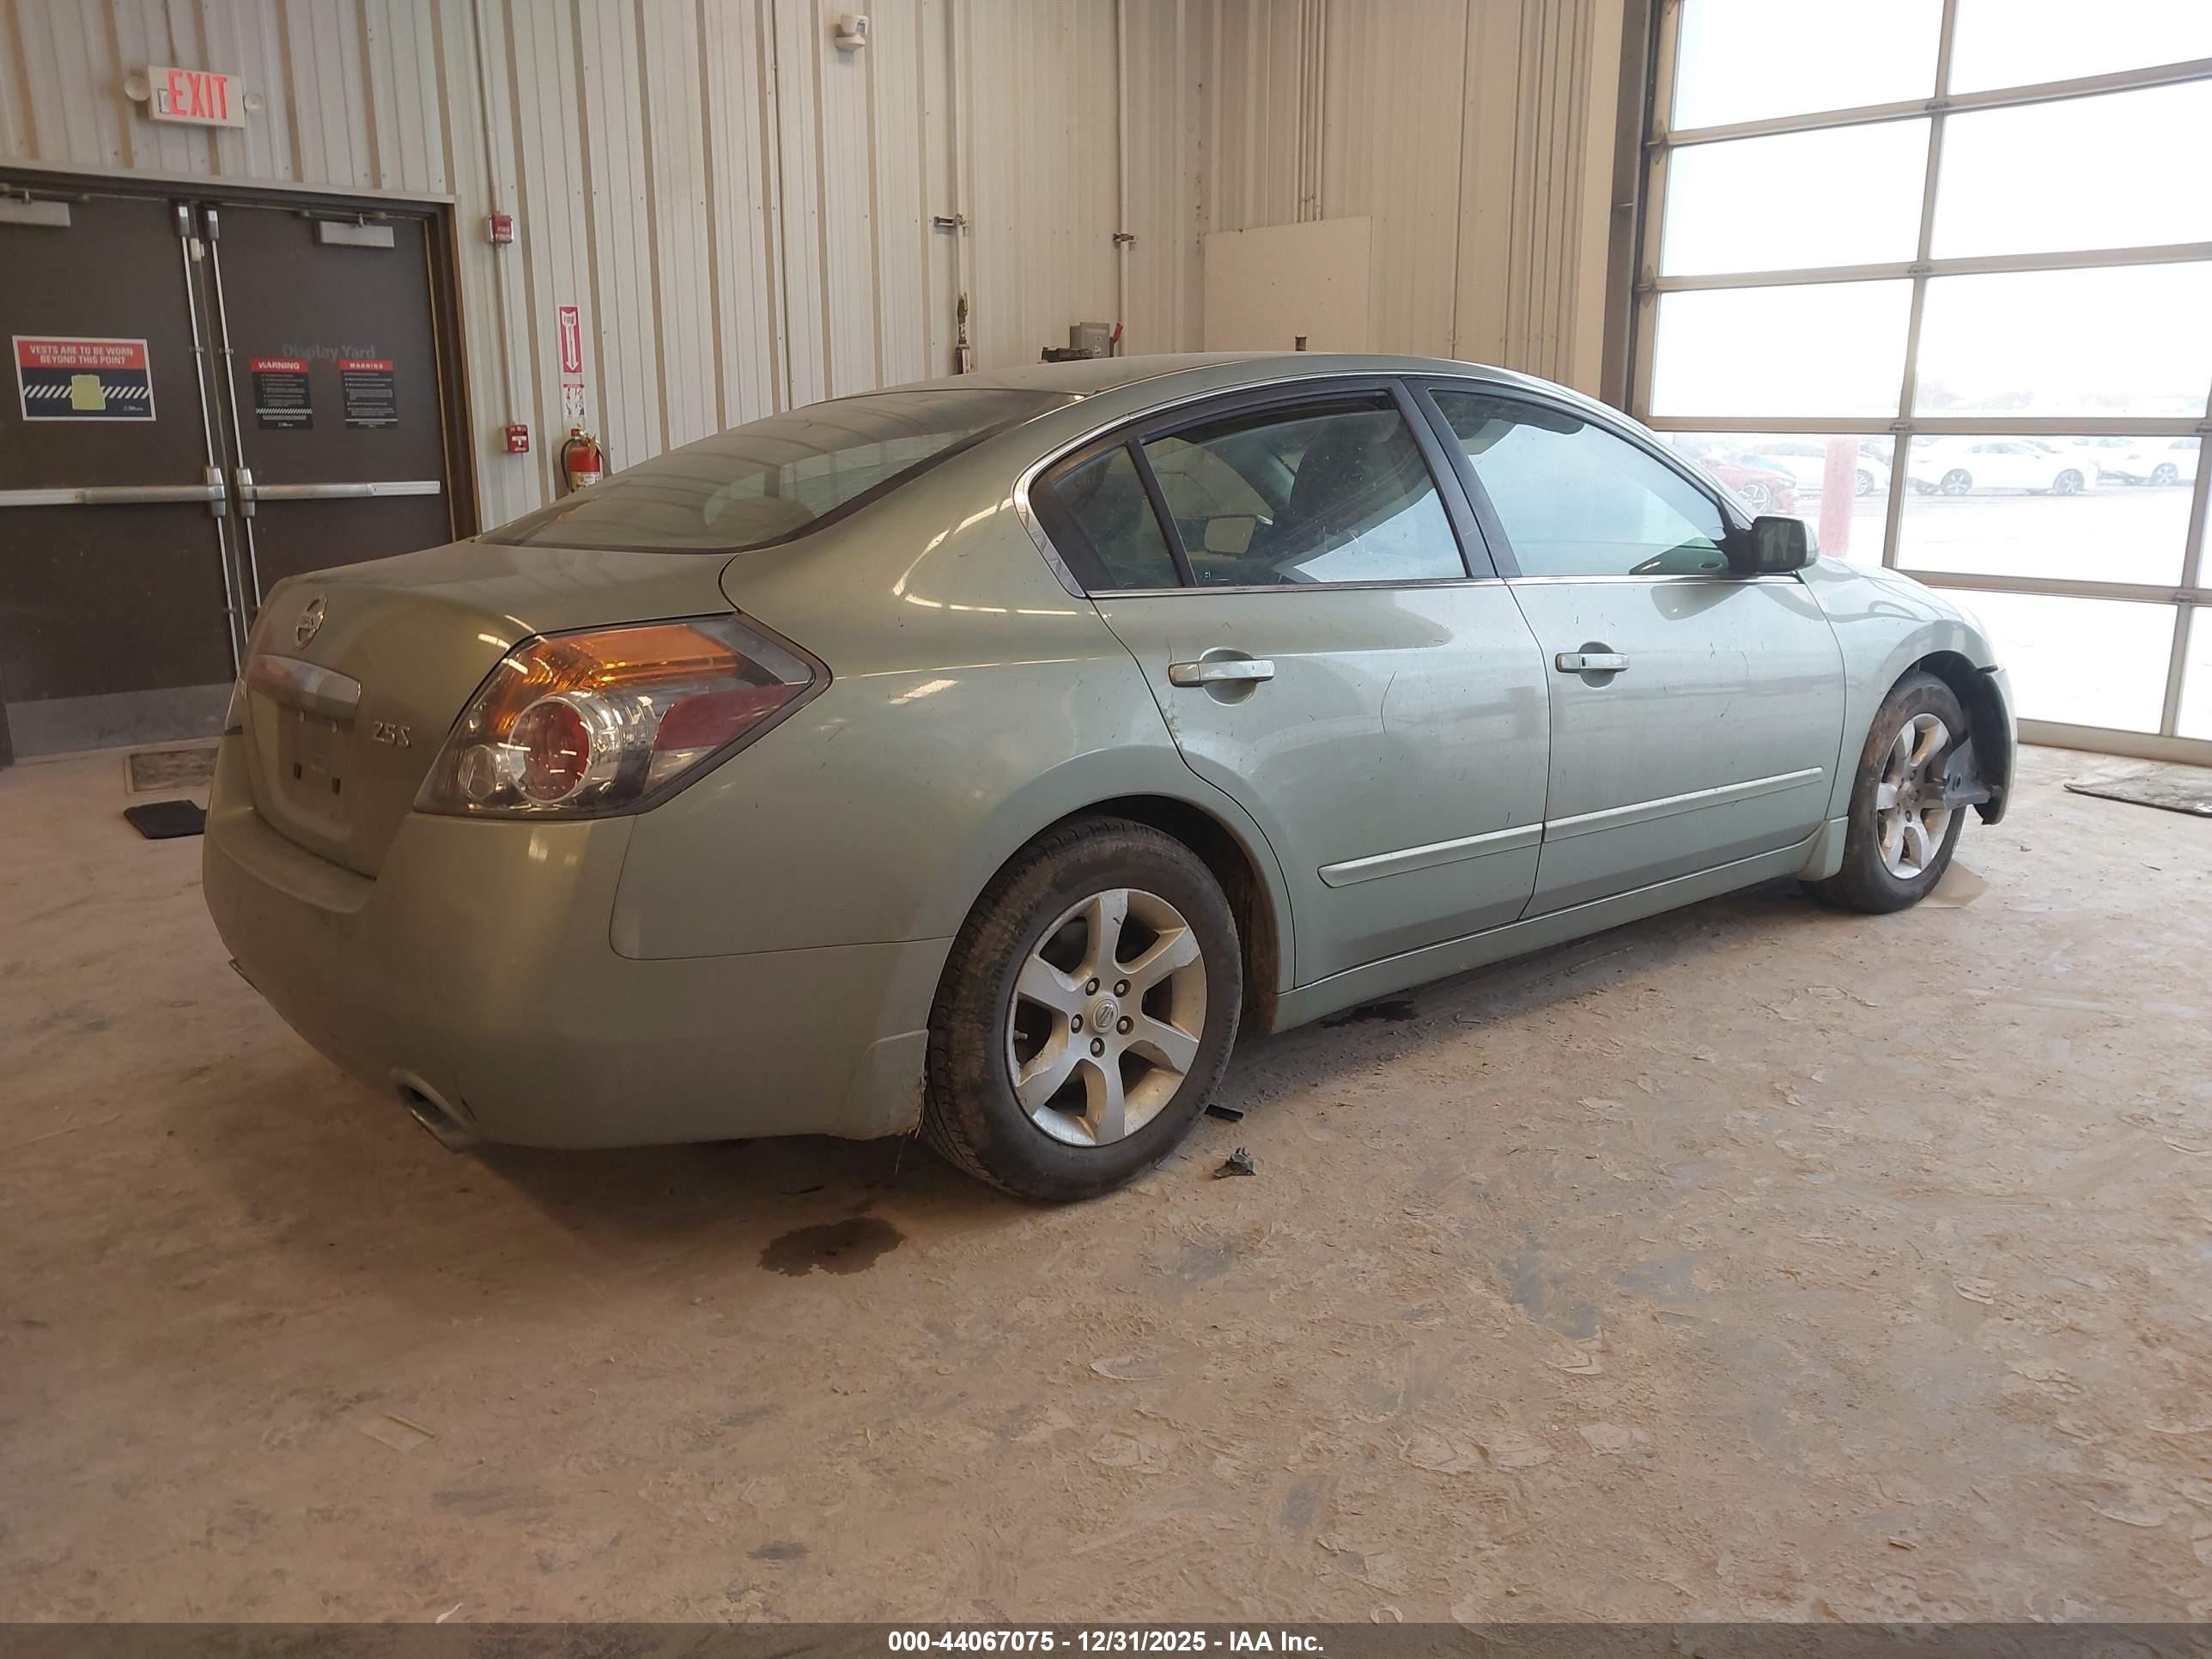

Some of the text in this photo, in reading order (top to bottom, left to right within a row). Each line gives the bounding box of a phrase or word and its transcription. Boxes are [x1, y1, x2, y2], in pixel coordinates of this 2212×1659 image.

[167, 70, 228, 119] EXIT
[563, 315, 574, 325] FIRE
[30, 344, 134, 356] VESTS ARE TO BE WORN
[283, 344, 375, 362] Display Yard
[40, 355, 126, 365] BEYOND THIS POINT
[258, 362, 301, 370] WARNING
